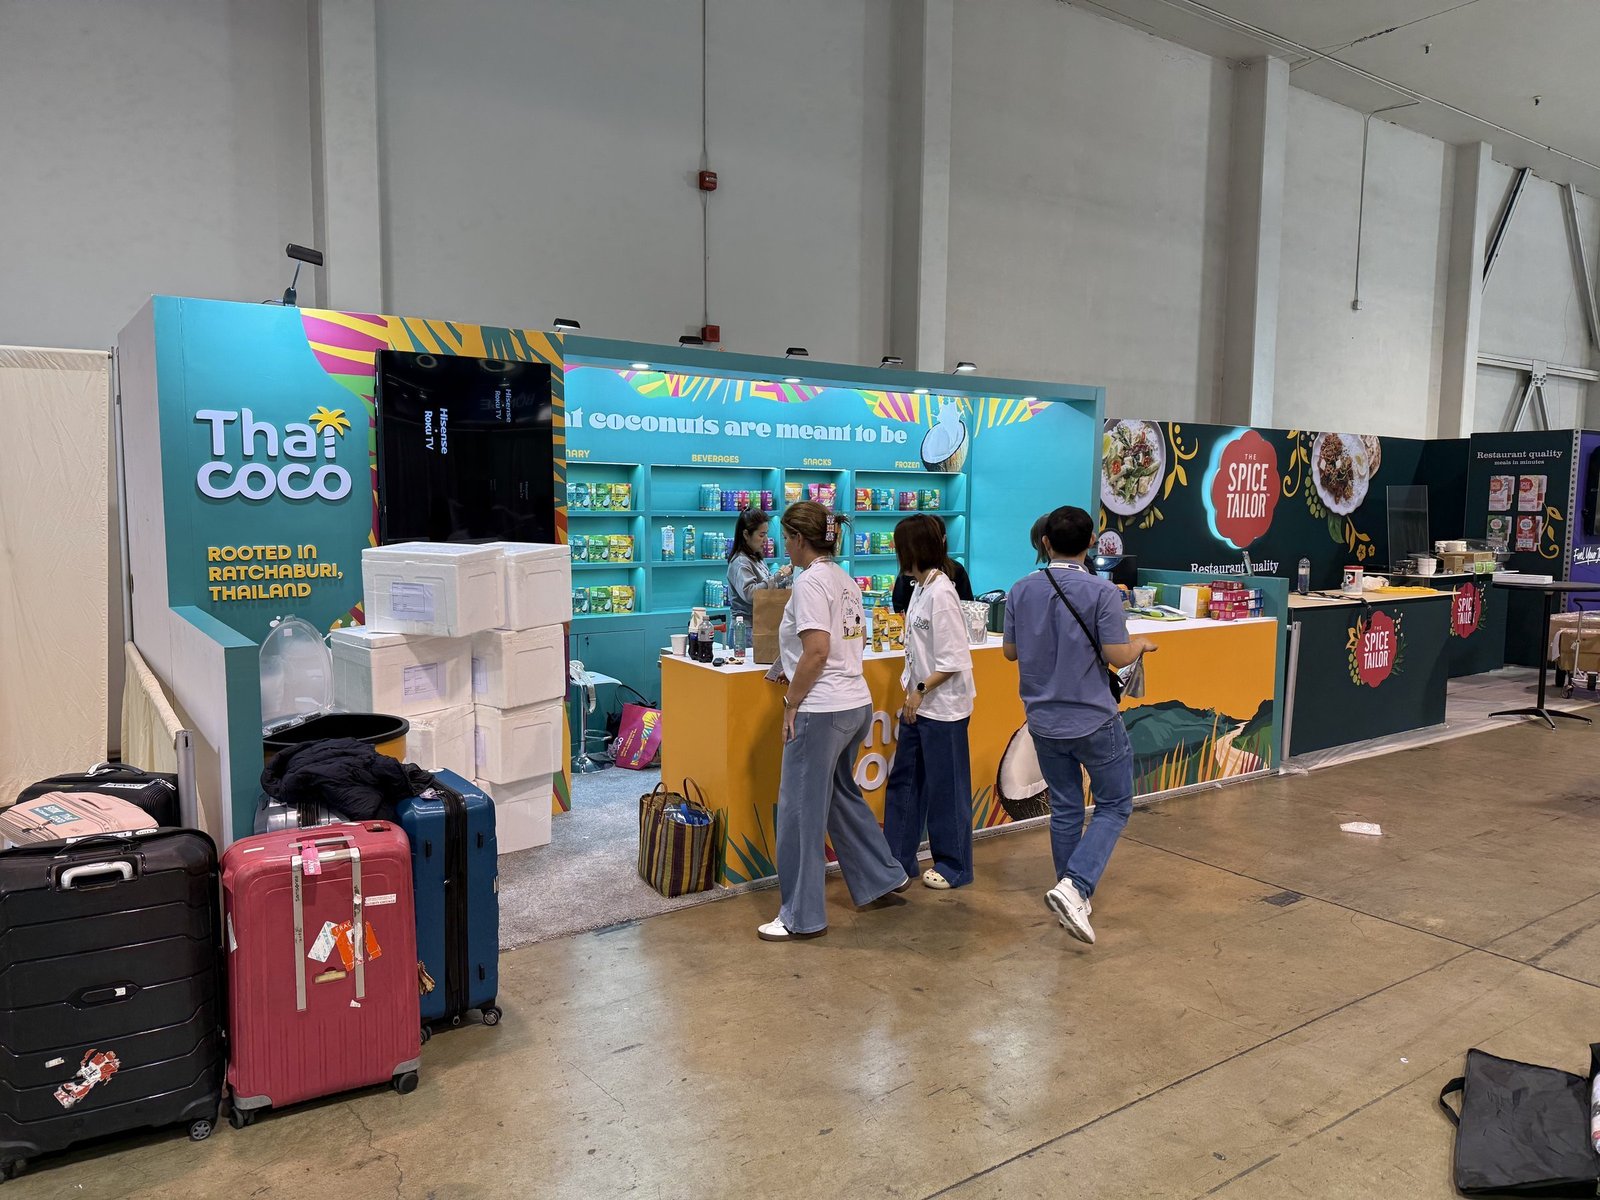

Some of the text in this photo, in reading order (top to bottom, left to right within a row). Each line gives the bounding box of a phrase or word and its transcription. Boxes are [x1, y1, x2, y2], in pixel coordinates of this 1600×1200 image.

[495, 410, 502, 419] TV
[196, 406, 350, 459] Thai
[424, 410, 434, 450] Roku TV
[440, 407, 448, 455] Hisense
[588, 412, 720, 436] coconuts
[724, 420, 772, 438] are
[776, 423, 852, 442] meant
[854, 425, 877, 443] to
[880, 425, 908, 444] be
[691, 454, 740, 464] BEVERAGES
[803, 458, 832, 466] SNACKS
[1244, 453, 1257, 461] THE
[1477, 449, 1563, 459] Restaurant quality
[895, 461, 920, 469] FROZEN
[1227, 462, 1269, 492] SPICE
[1226, 493, 1267, 519] TAILOR
[208, 544, 317, 562] ROOTED IN
[209, 563, 343, 582] RATCHABURI,
[1190, 560, 1280, 574] Restaurant uality
[209, 582, 312, 601] THAILAND
[1457, 597, 1474, 612] SPIC
[1364, 631, 1389, 652] SPICE
[1364, 650, 1389, 669] TAILOR
